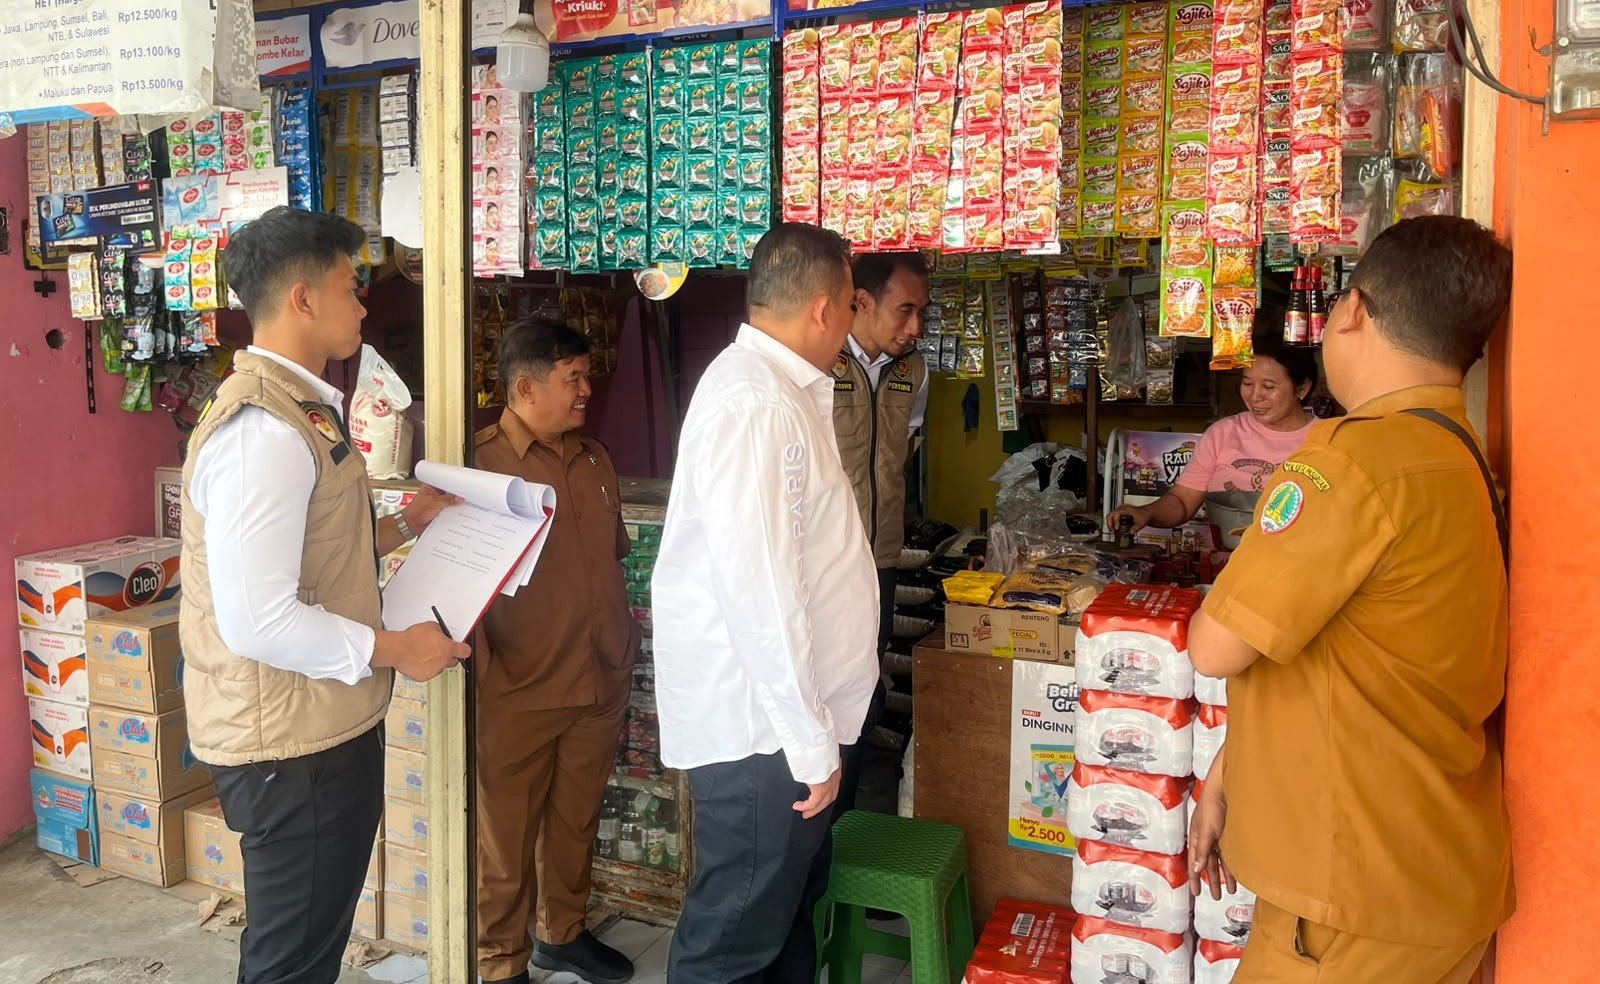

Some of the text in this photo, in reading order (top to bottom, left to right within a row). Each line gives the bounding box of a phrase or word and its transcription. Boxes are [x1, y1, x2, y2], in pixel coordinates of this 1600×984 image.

[567, 3, 603, 13] Kriuk!
[1026, 3, 1046, 15] Royco
[1129, 4, 1165, 18] Masako
[118, 9, 178, 24] Rp12.500/kg
[1175, 7, 1214, 24] Sajiku
[3, 25, 23, 36] Jawa,
[61, 12, 90, 26] Sumsel,
[373, 18, 420, 44] Dove
[1296, 18, 1321, 30] Royco
[68, 30, 73, 40] &
[75, 26, 110, 38] Sulawesi
[1218, 27, 1242, 37] Royco
[273, 35, 299, 46] Bubar
[120, 46, 181, 60] Rp13.100/kg
[281, 47, 305, 58] Kelar
[1024, 44, 1044, 54] Royco
[1088, 46, 1120, 61] Masako
[1128, 40, 1162, 56] Masako
[1273, 45, 1290, 53] SAO
[27, 53, 60, 65] Lampung
[61, 51, 74, 60] dan
[44, 61, 112, 77] NTT & Kalimantan
[1216, 71, 1240, 82] Royco
[43, 83, 114, 99] Maluku dan Papua
[122, 79, 184, 93] Rp13.500/kg
[1087, 85, 1119, 99] Masako
[1173, 77, 1210, 94] Sajiku
[1271, 93, 1290, 102] SAO
[1215, 116, 1238, 126] Royco
[1022, 129, 1041, 139] Royco
[1086, 123, 1119, 137] Masako
[126, 150, 145, 159] CLEAR
[1171, 146, 1208, 163] Sajiku
[1122, 160, 1155, 174] Masako
[1213, 162, 1236, 171] Royco
[1267, 191, 1290, 200] SAOR
[350, 415, 368, 428] CANA
[784, 442, 806, 540] PARIS
[133, 578, 158, 595] Cleo
[1021, 614, 1050, 622] RENTENG
[116, 633, 139, 651] Club
[1048, 684, 1079, 698] Beli
[122, 719, 146, 737] Club
[1022, 717, 1075, 735] DINGINN
[124, 803, 147, 821] Club
[1019, 816, 1040, 826] Hanya
[1028, 826, 1066, 843] 2.500
